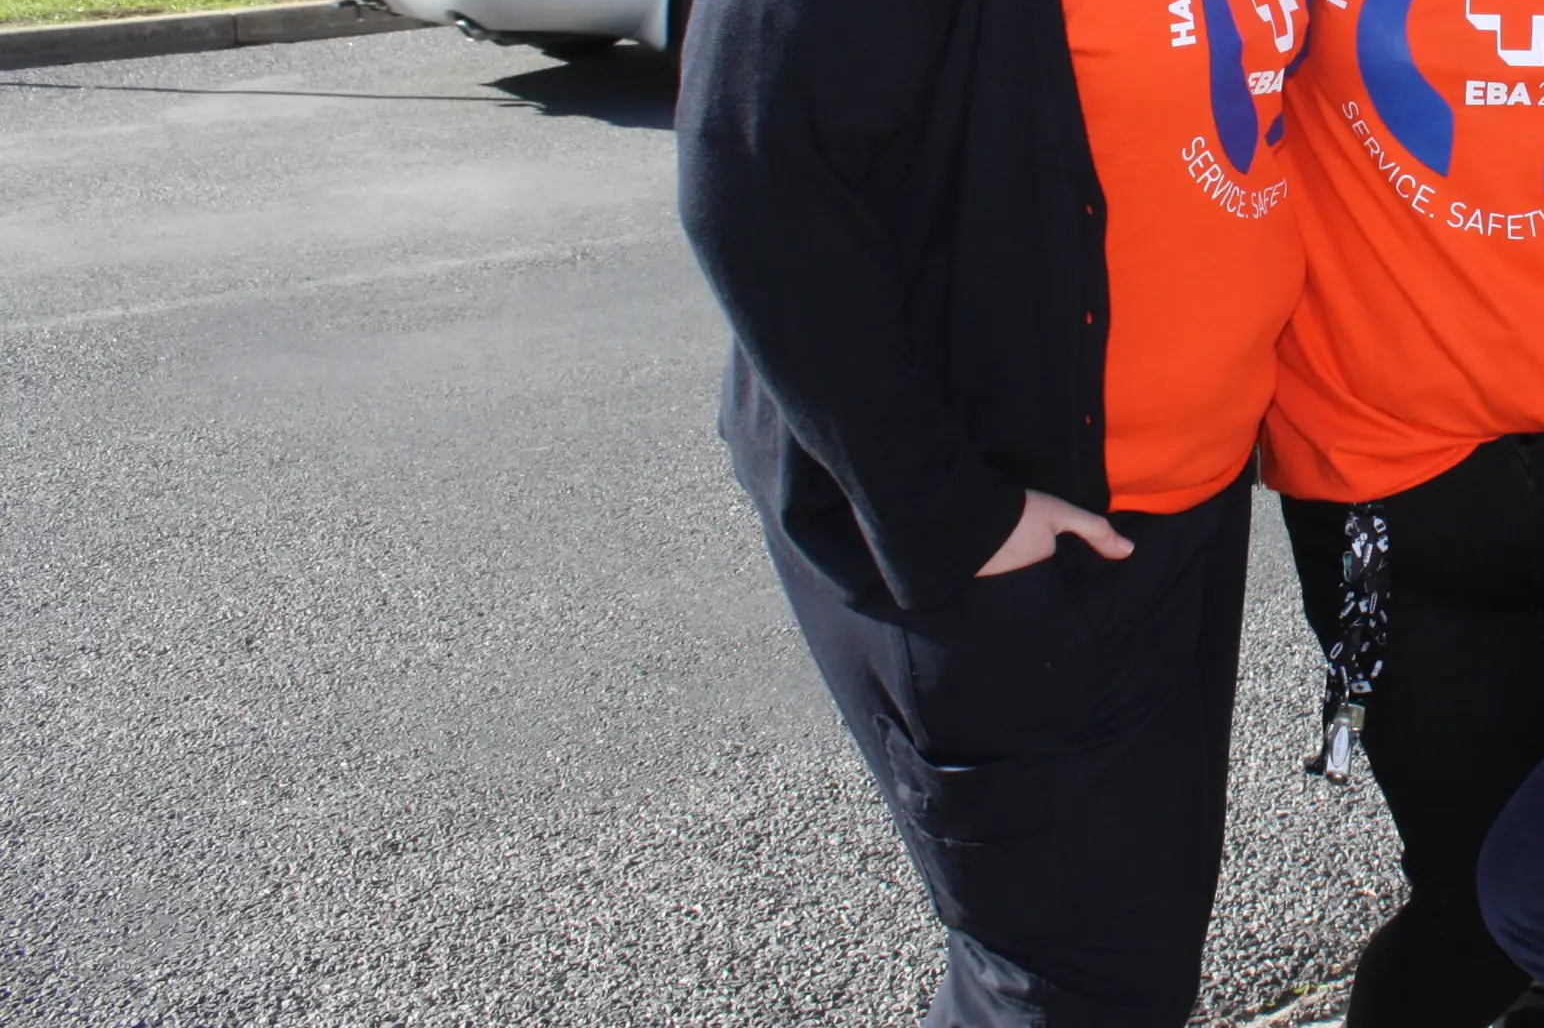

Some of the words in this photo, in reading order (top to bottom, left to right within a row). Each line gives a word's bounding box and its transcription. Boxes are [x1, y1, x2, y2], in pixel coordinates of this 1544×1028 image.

[1464, 80, 1532, 106] EBA
[1181, 136, 1249, 219] SERVICE.
[1341, 100, 1436, 219] SERVICE.
